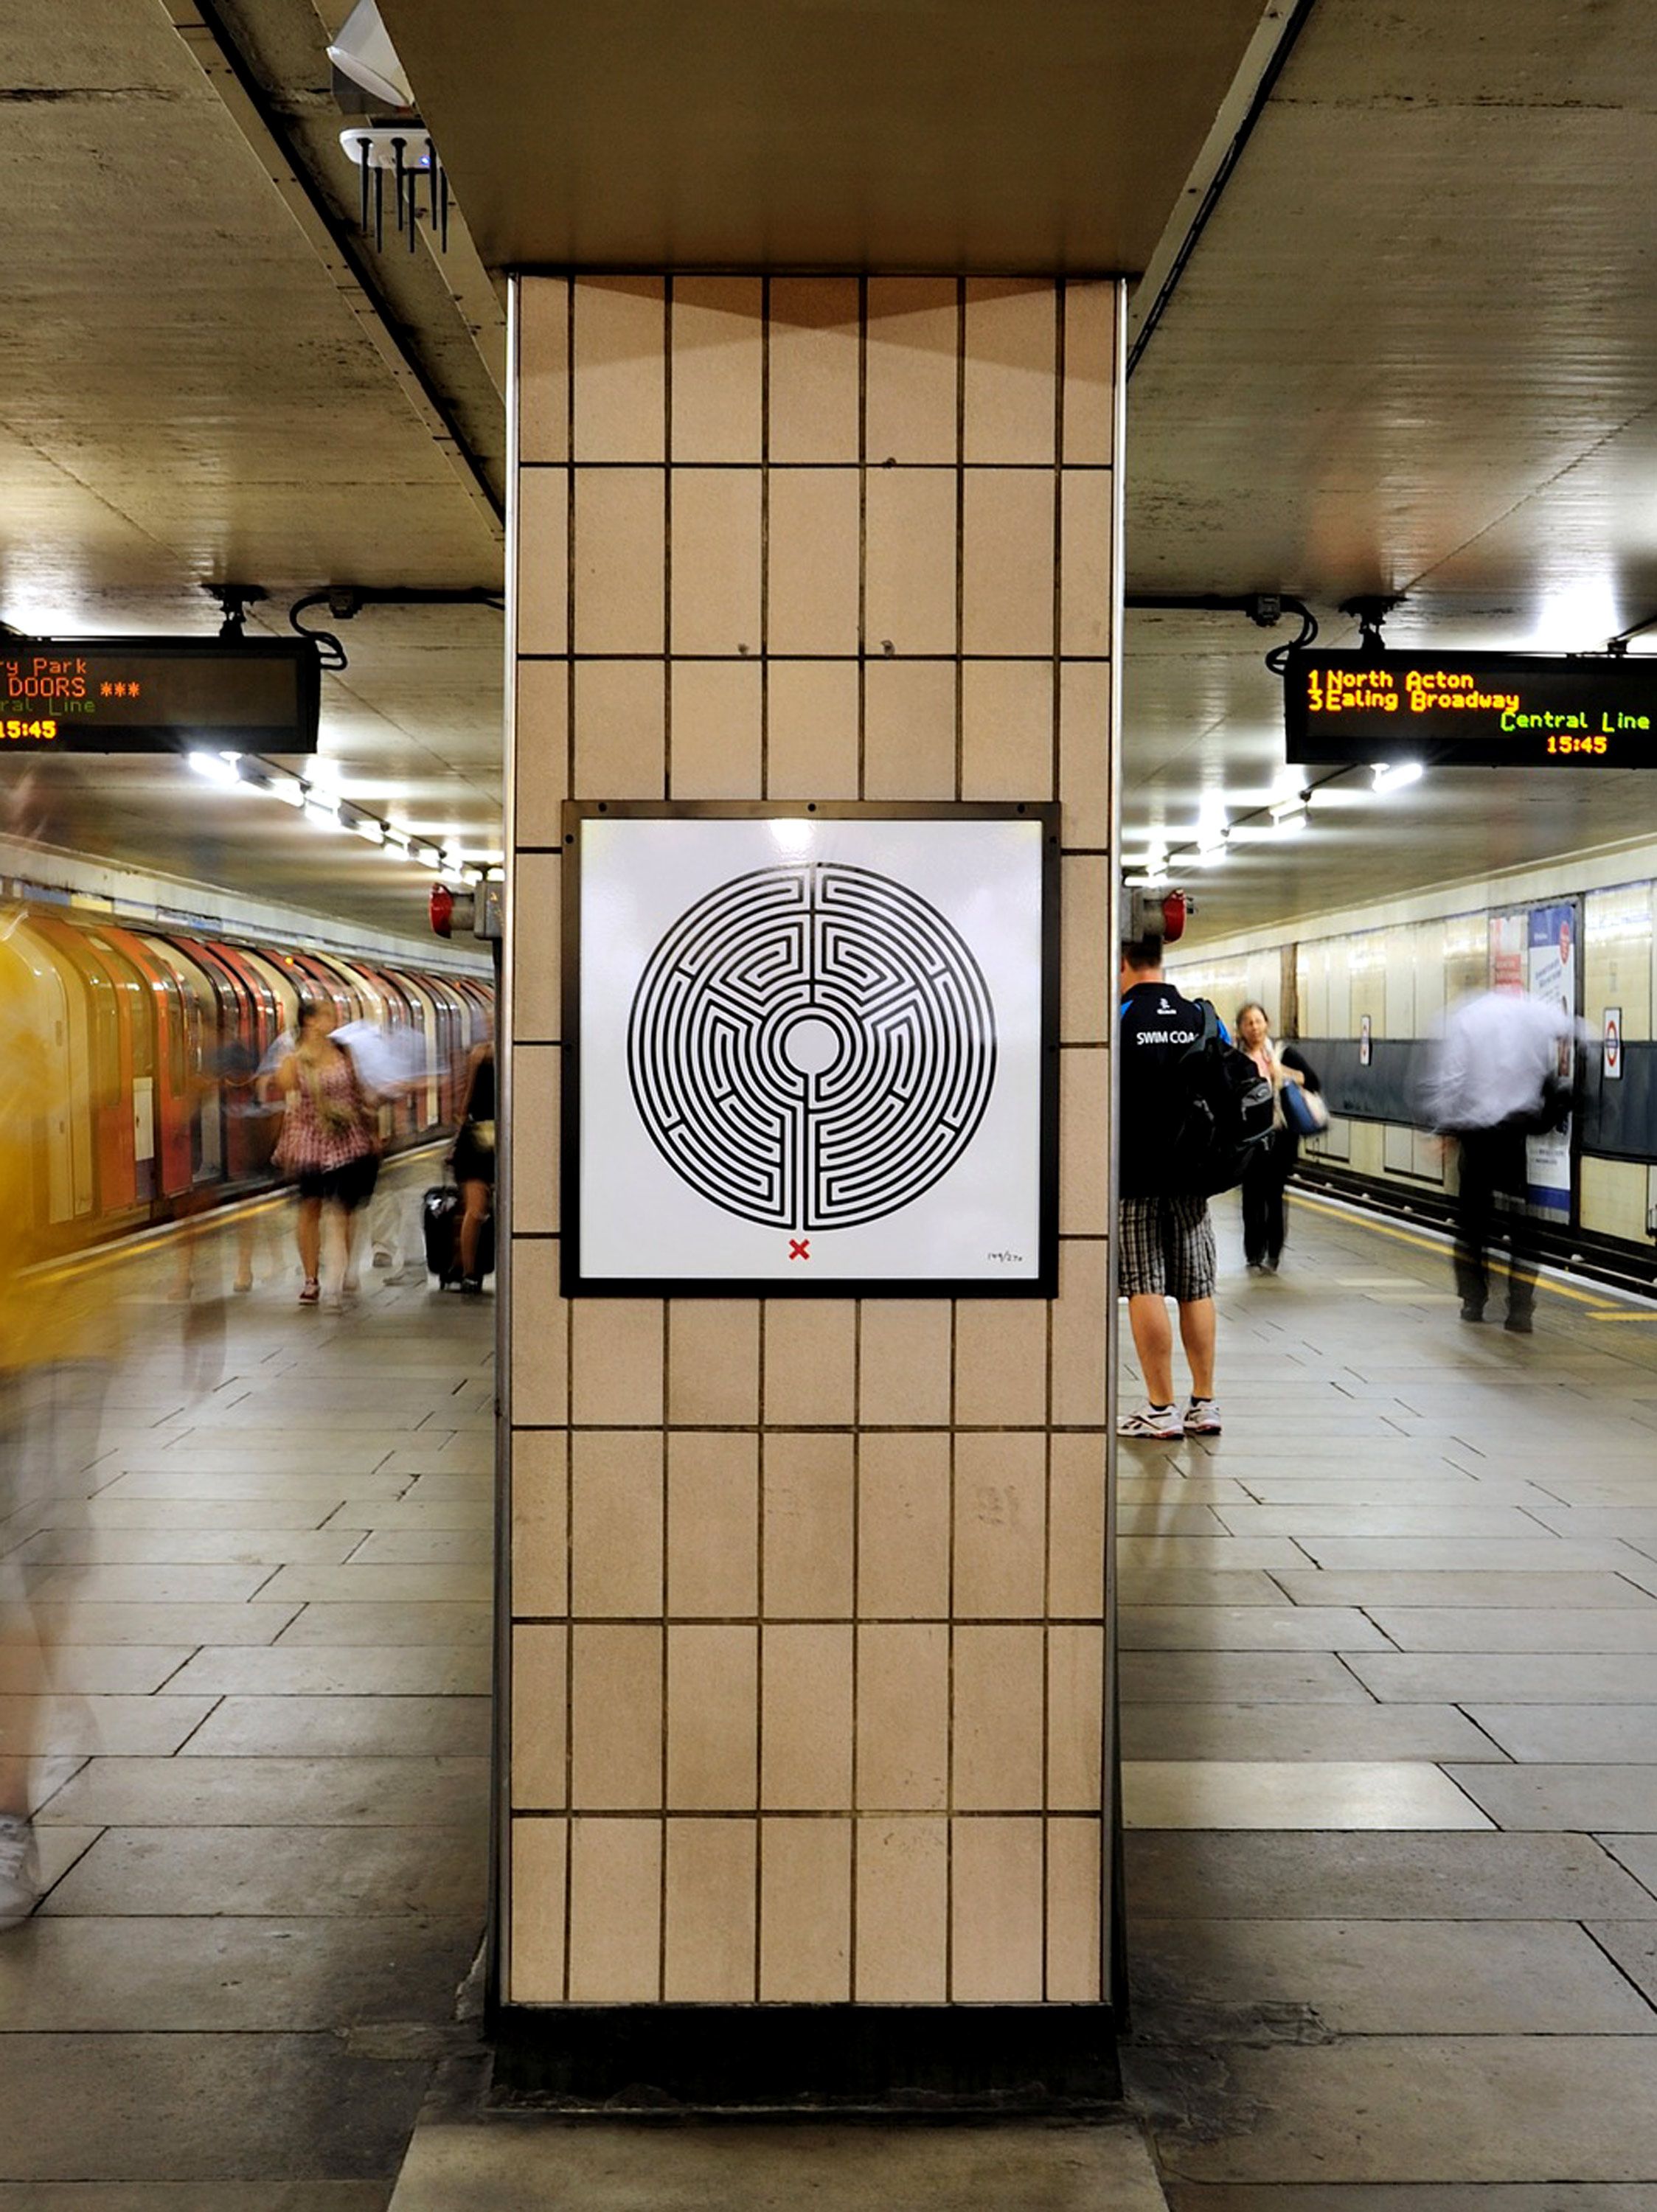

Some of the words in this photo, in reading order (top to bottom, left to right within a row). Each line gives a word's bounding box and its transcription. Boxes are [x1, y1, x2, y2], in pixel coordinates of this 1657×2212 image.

[33, 657, 87, 677] Park
[9, 677, 86, 698] DOORS
[1307, 669, 1319, 690] 1
[1327, 669, 1394, 690] North
[1405, 669, 1475, 692] Acton
[49, 697, 96, 716] Line
[1307, 689, 1324, 712] 3
[1325, 689, 1399, 712] Ealing
[1410, 689, 1520, 714] Broadway
[0, 720, 57, 739] 15:45
[1500, 711, 1589, 732] Central
[1602, 712, 1651, 733] Line
[1547, 735, 1608, 754] 15:45
[1136, 1031, 1169, 1046] SWIM
[1169, 1030, 1199, 1044] COA
